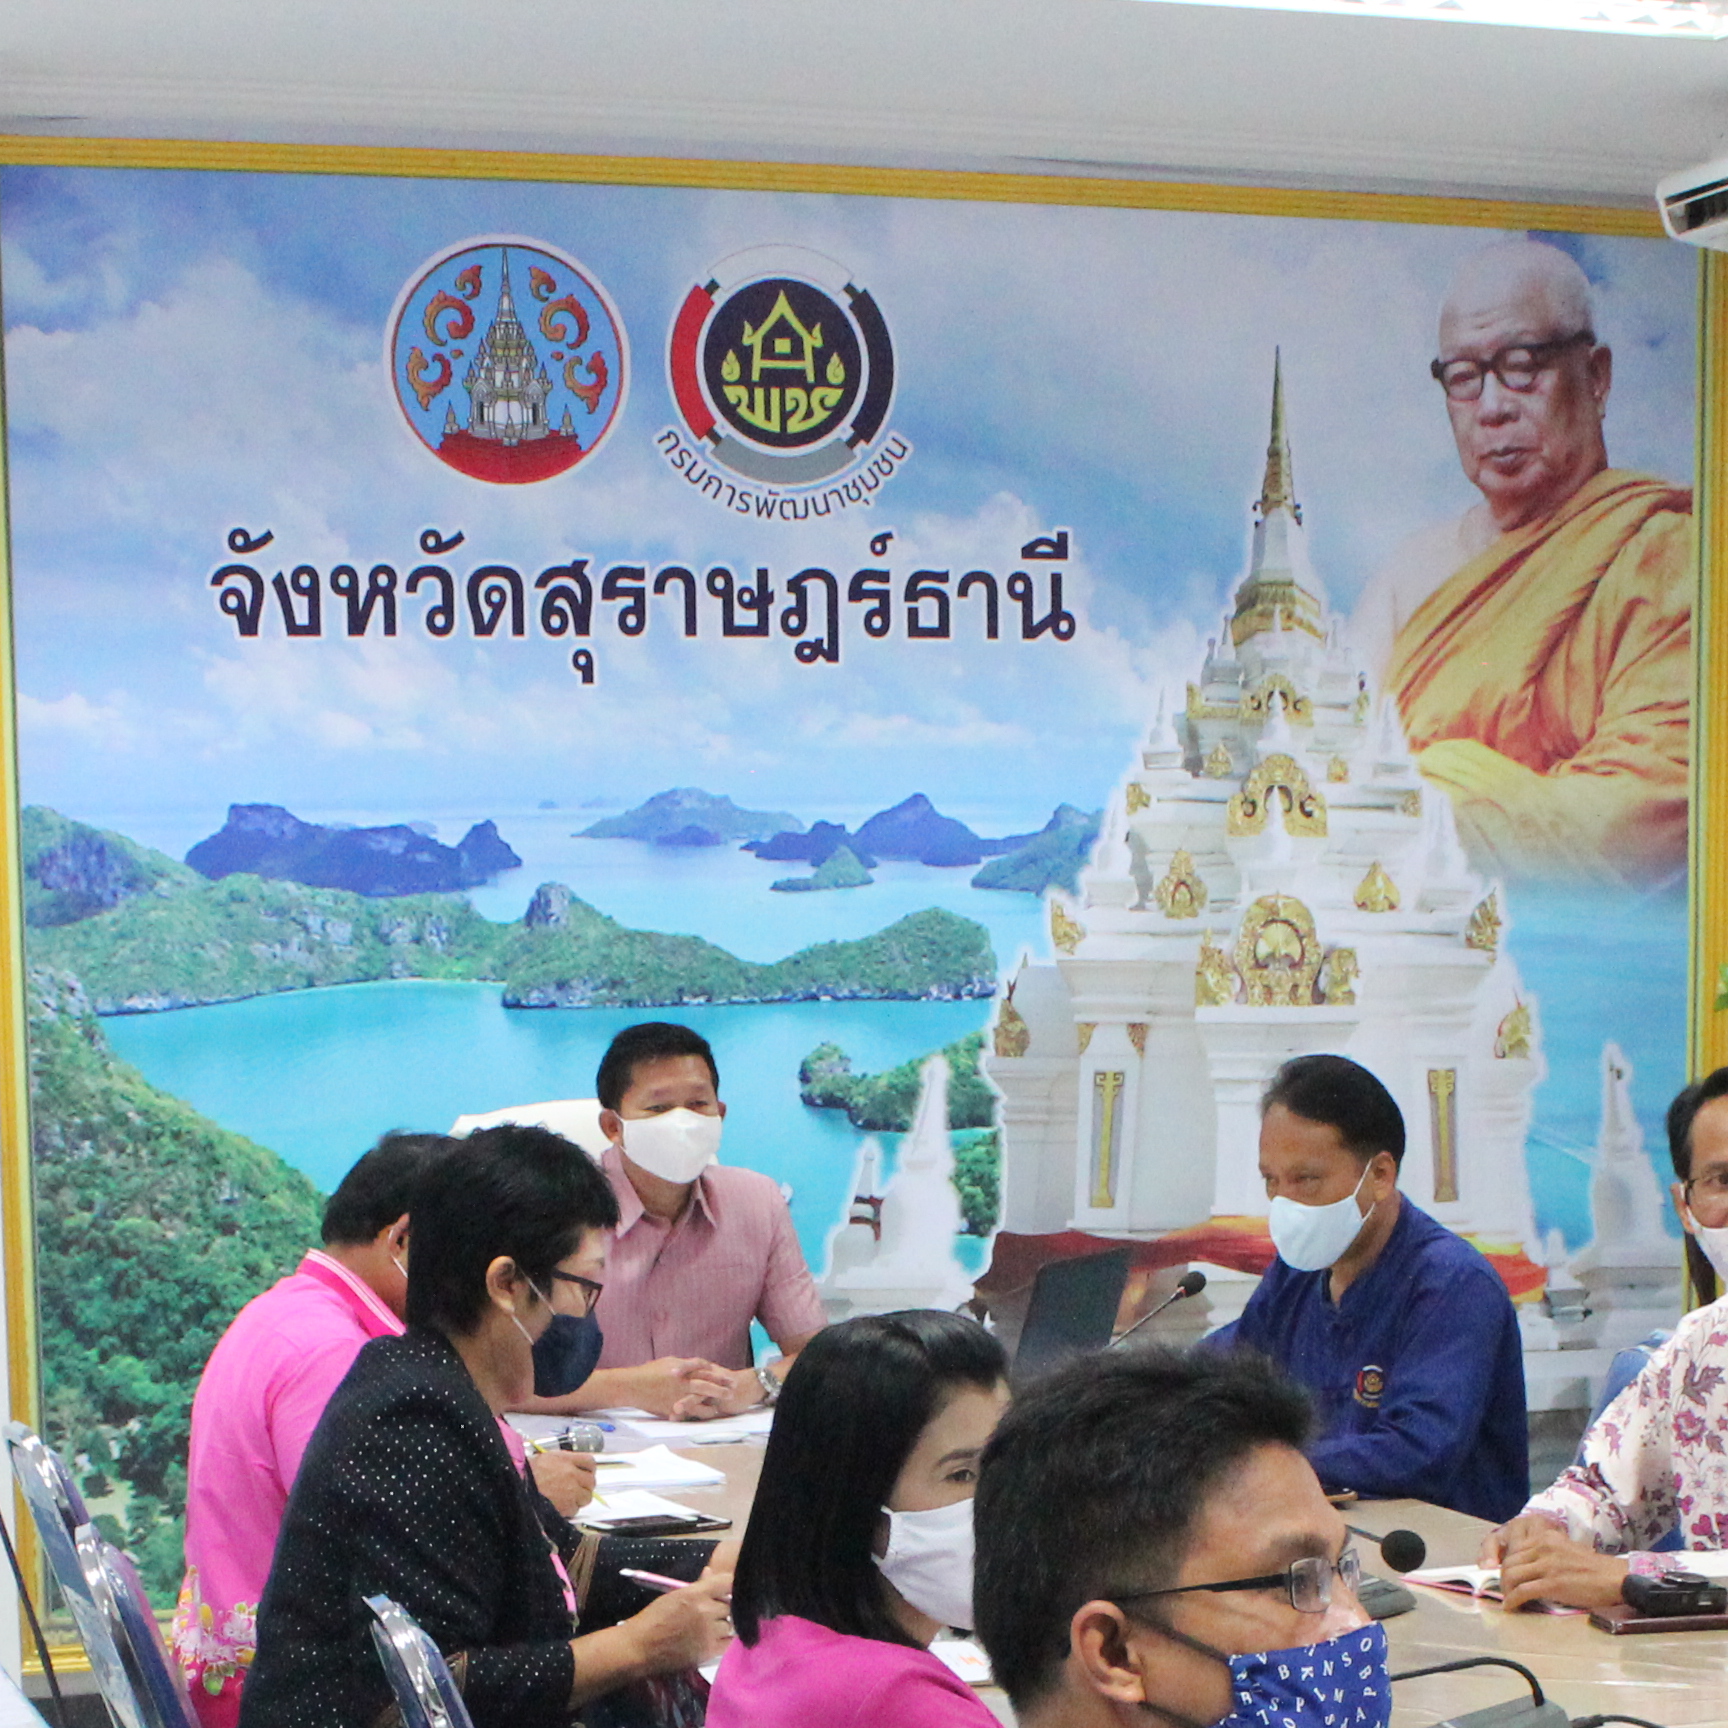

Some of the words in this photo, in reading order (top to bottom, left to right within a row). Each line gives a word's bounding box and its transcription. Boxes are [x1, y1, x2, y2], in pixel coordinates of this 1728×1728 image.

[658, 429, 909, 520] กรมการพัฒนาชุมชน
[210, 527, 1076, 685] จังหวัดสุราษฎร์ธานี
